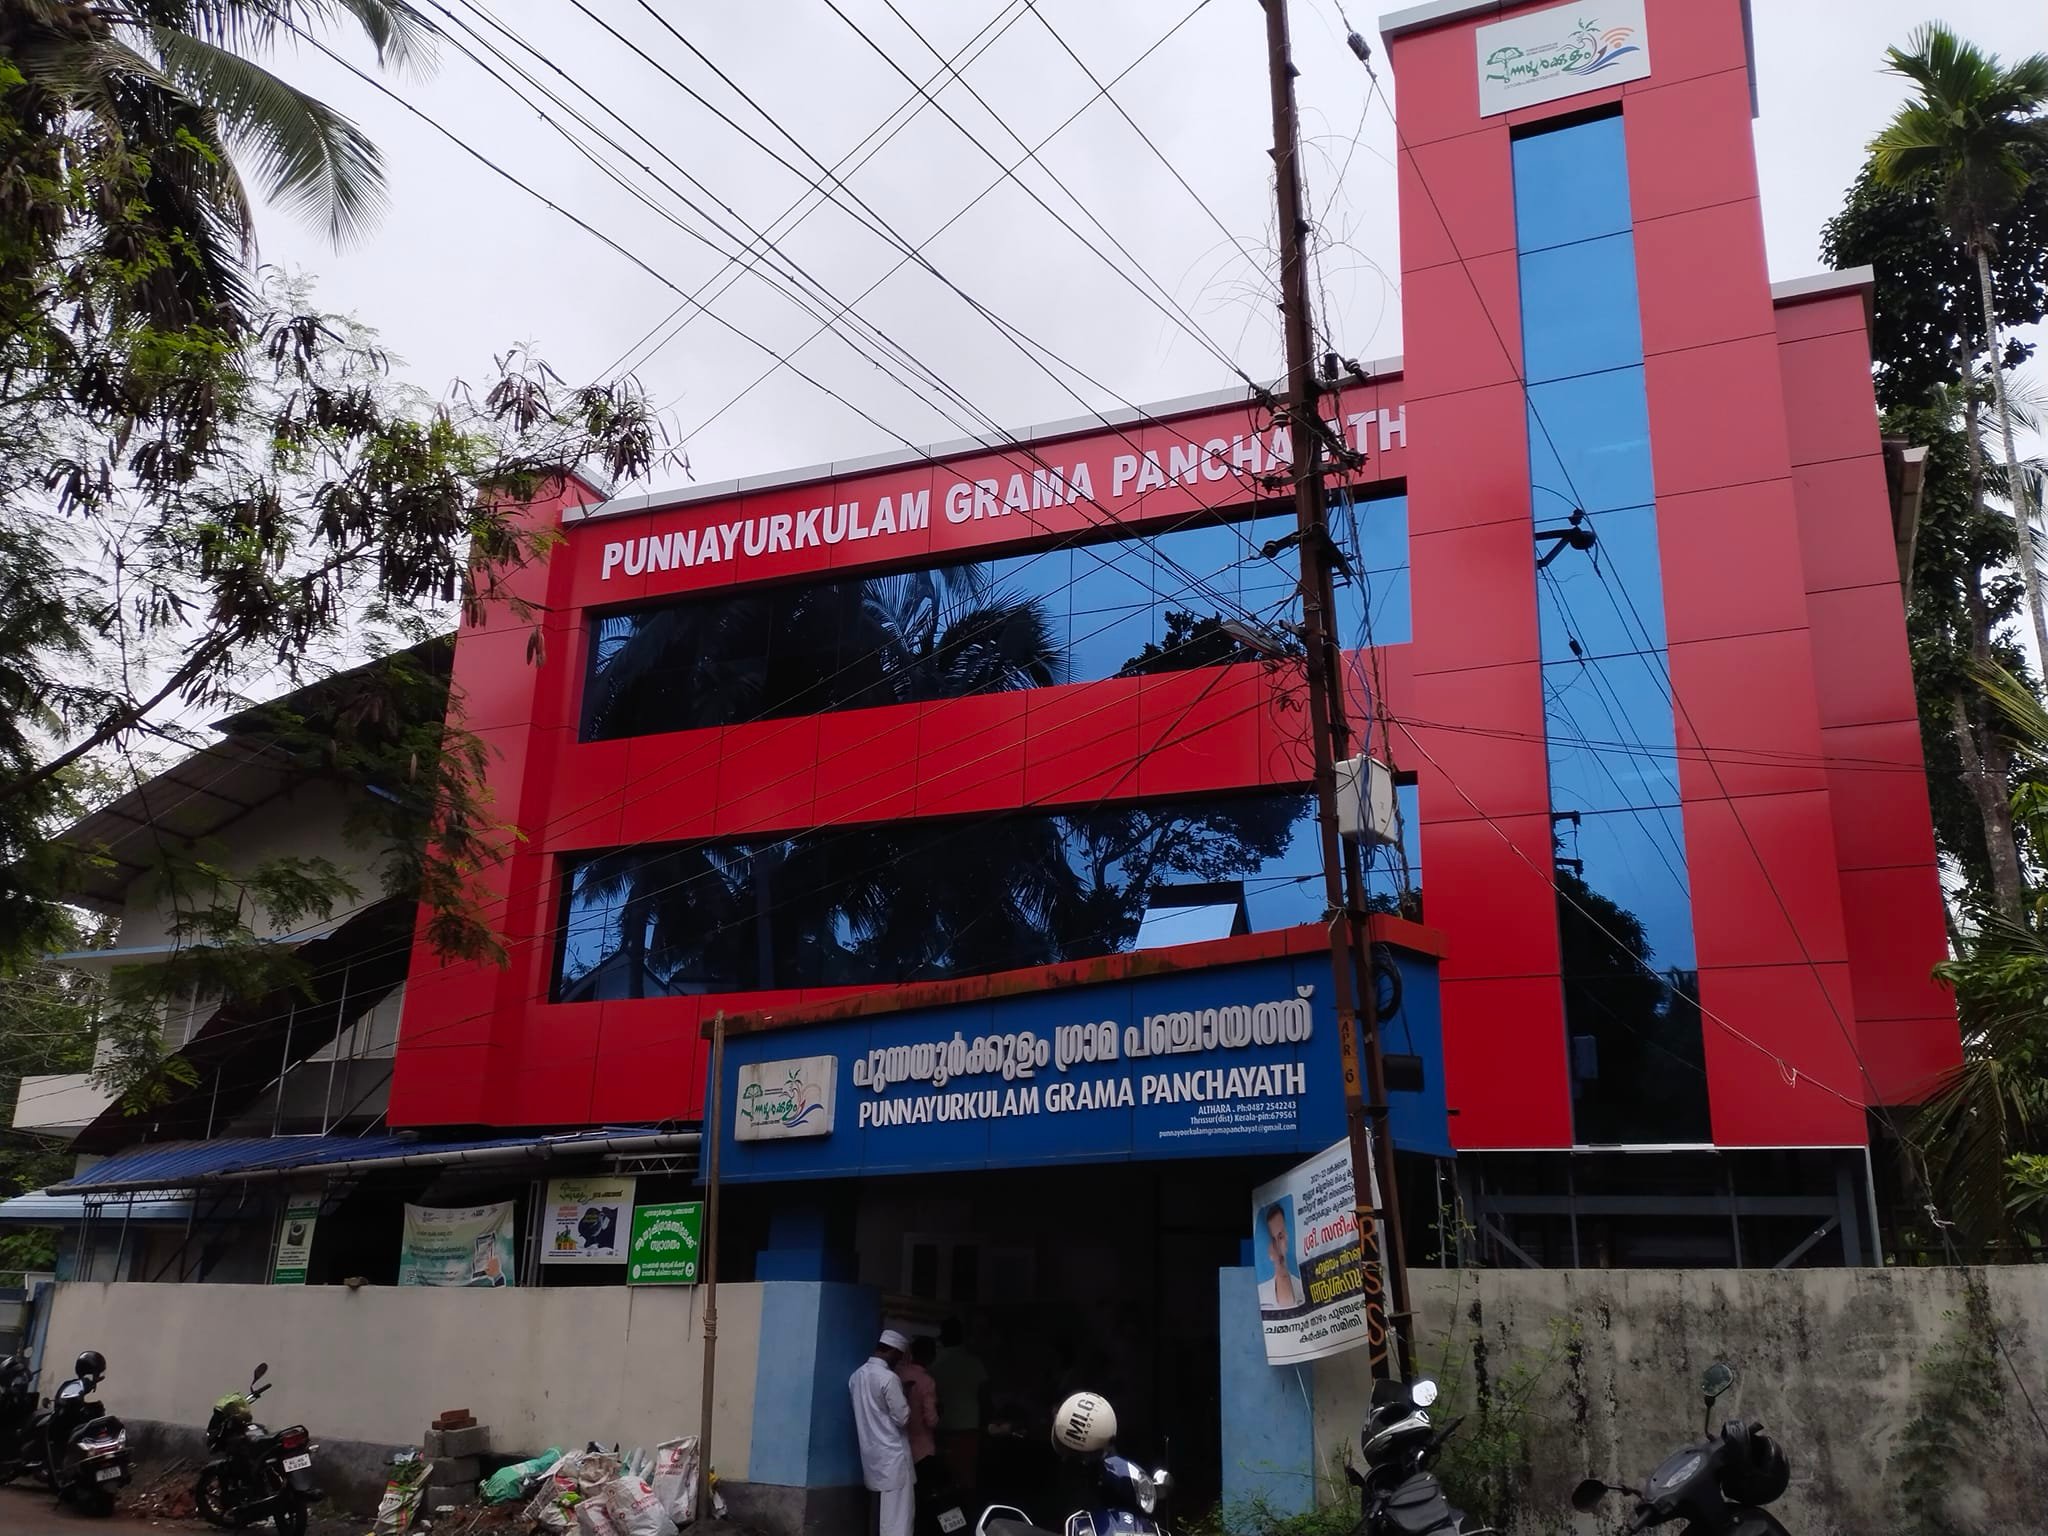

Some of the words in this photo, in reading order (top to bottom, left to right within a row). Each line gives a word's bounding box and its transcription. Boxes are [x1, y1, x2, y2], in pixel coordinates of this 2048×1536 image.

[601, 489, 931, 581] PUNNAYURKULAM
[944, 462, 1095, 525] GRAMA
[1112, 404, 1407, 497] PANCHATH
[1055, 1020, 1119, 1072] ഗ്രാമ
[1124, 984, 1315, 1058] പഞ്ചായത്ത്
[858, 1086, 1040, 1128] PUNNAYURKULAM
[1045, 1077, 1135, 1112] GRAMA
[1141, 1062, 1306, 1105] PANCHAYATH
[1198, 1104, 1231, 1115] ALTHARA
[1266, 1101, 1296, 1111] 2542243
[1330, 1313, 1362, 1334] സമിതി
